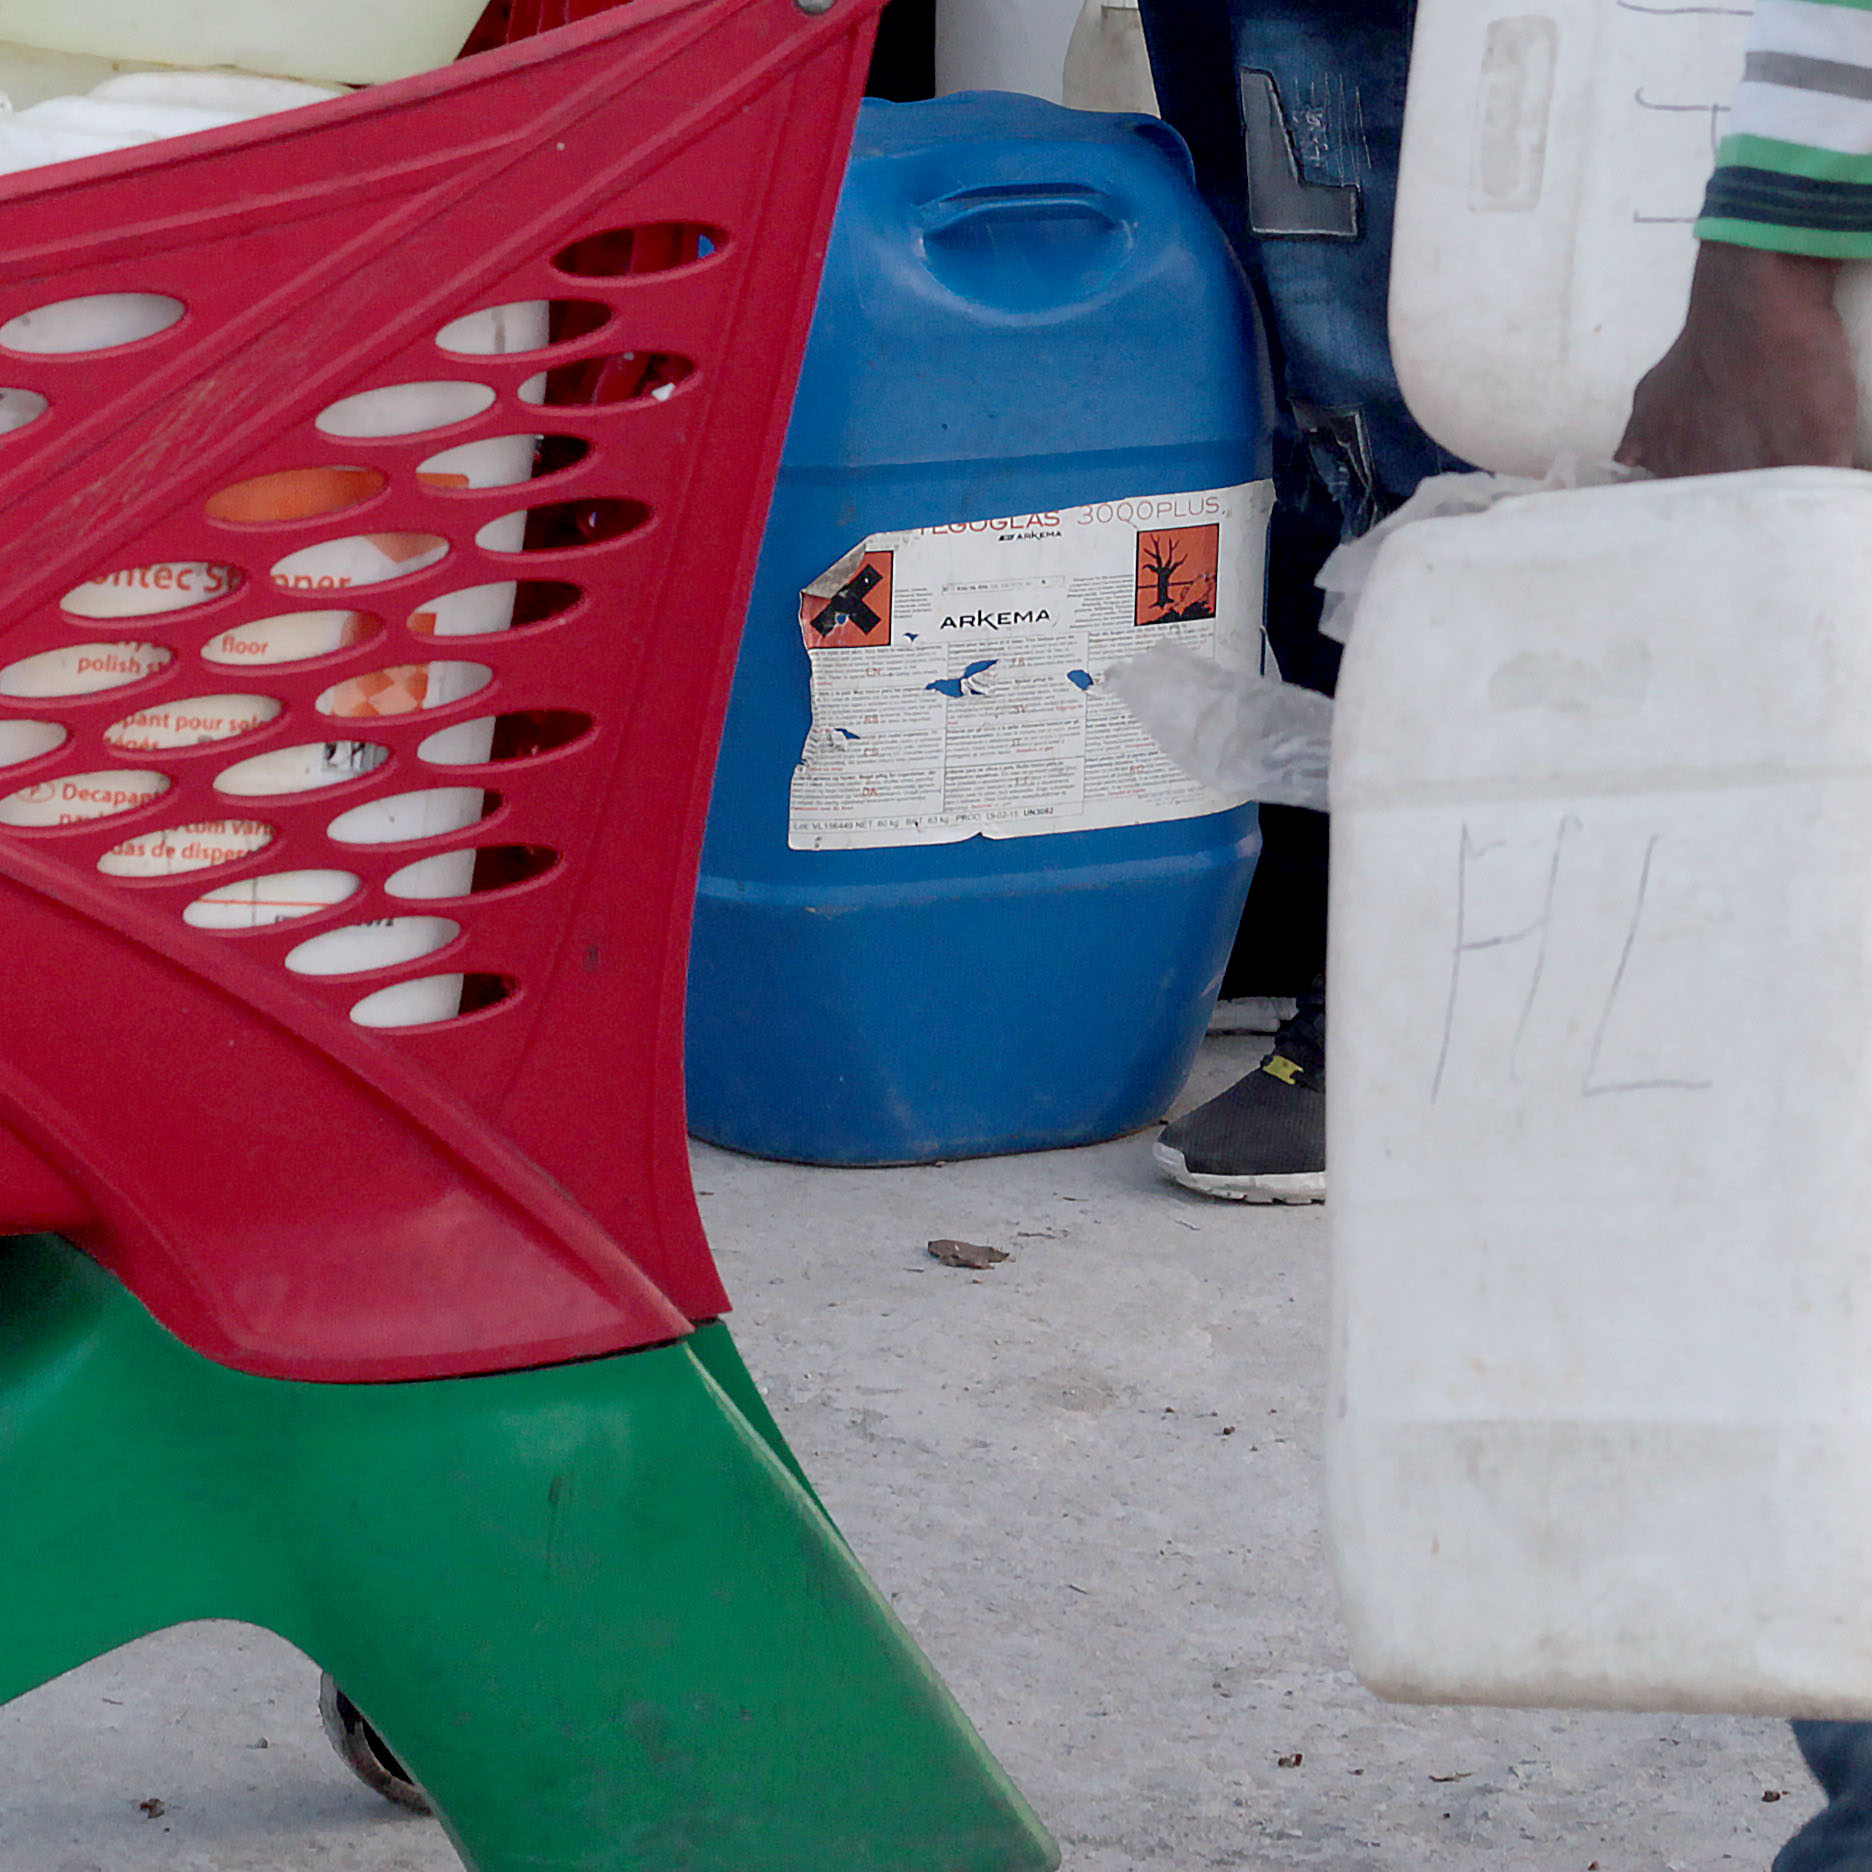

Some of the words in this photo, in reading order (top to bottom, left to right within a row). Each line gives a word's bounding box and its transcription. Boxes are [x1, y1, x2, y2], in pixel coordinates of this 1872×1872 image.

[919, 510, 1061, 536] EGOGLAS
[1016, 530, 1062, 540] ARKEMA
[939, 608, 1051, 630] ARKEMA
[222, 635, 270, 655] floor
[77, 654, 141, 676] polish
[175, 713, 223, 732] pour
[151, 840, 176, 859] de
